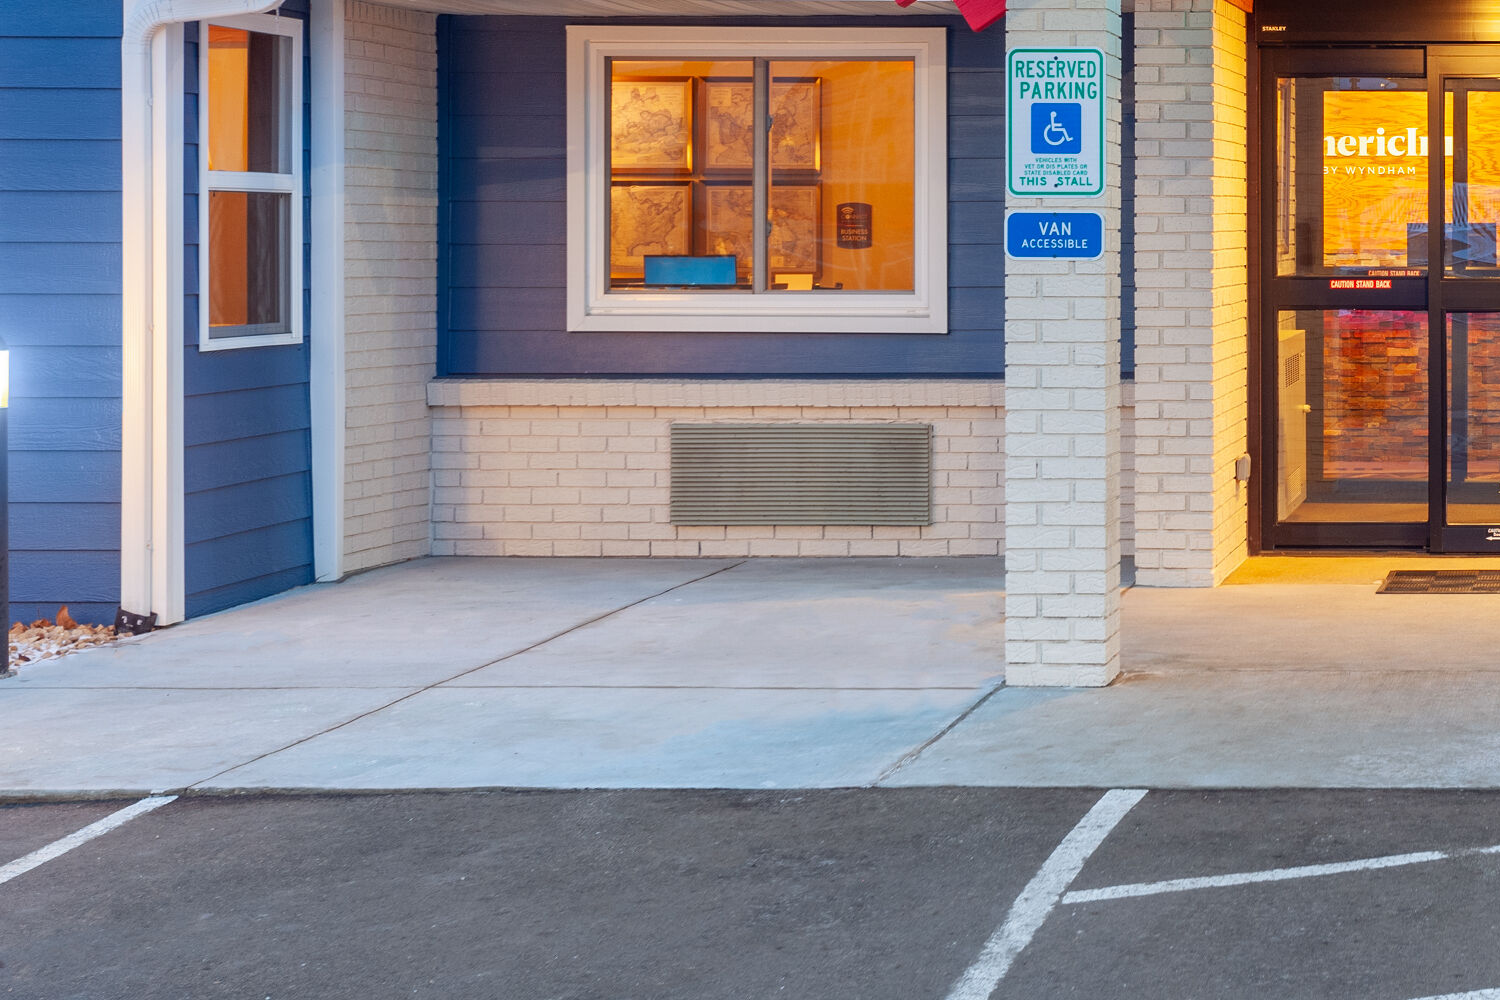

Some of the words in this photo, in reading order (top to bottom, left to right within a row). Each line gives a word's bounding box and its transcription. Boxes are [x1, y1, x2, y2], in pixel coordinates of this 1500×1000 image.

[1015, 60, 1096, 78] RESERVED
[1020, 82, 1098, 100] PARKING
[1345, 166, 1416, 174] WYNDHAM
[1019, 176, 1047, 186] THIS
[1057, 176, 1093, 186] STALL
[1039, 222, 1072, 236] VAN
[1021, 239, 1088, 249] ACCESSIBLE
